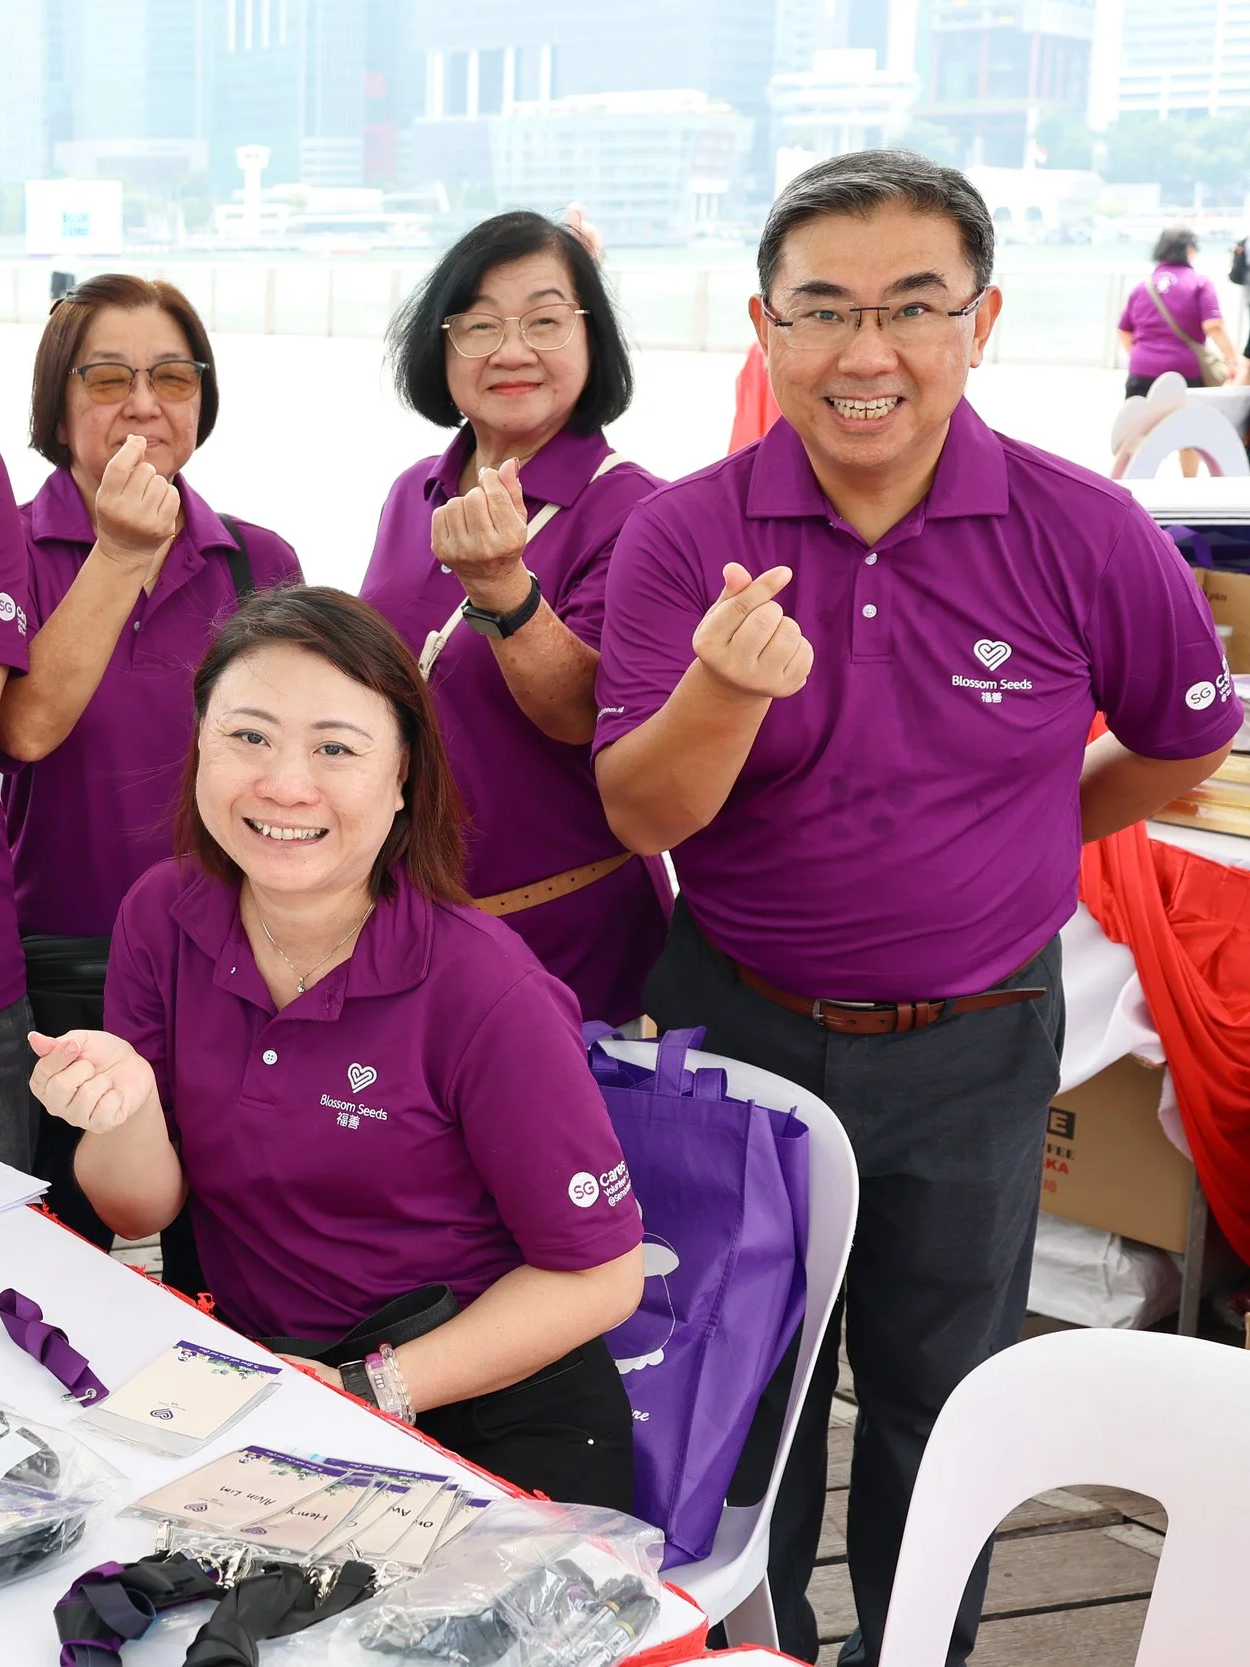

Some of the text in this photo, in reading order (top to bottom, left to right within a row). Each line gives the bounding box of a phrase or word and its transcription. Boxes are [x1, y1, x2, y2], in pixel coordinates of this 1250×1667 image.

[951, 674, 1033, 690] Blossom Seeds
[1190, 686, 1212, 705] SG
[319, 1093, 388, 1121] Blossom Seeds
[336, 1111, 361, 1130] 福善
[599, 1160, 626, 1187] Cares
[573, 1181, 595, 1200] SG
[246, 1492, 277, 1506] Alvin
[285, 1506, 329, 1522] Henry
